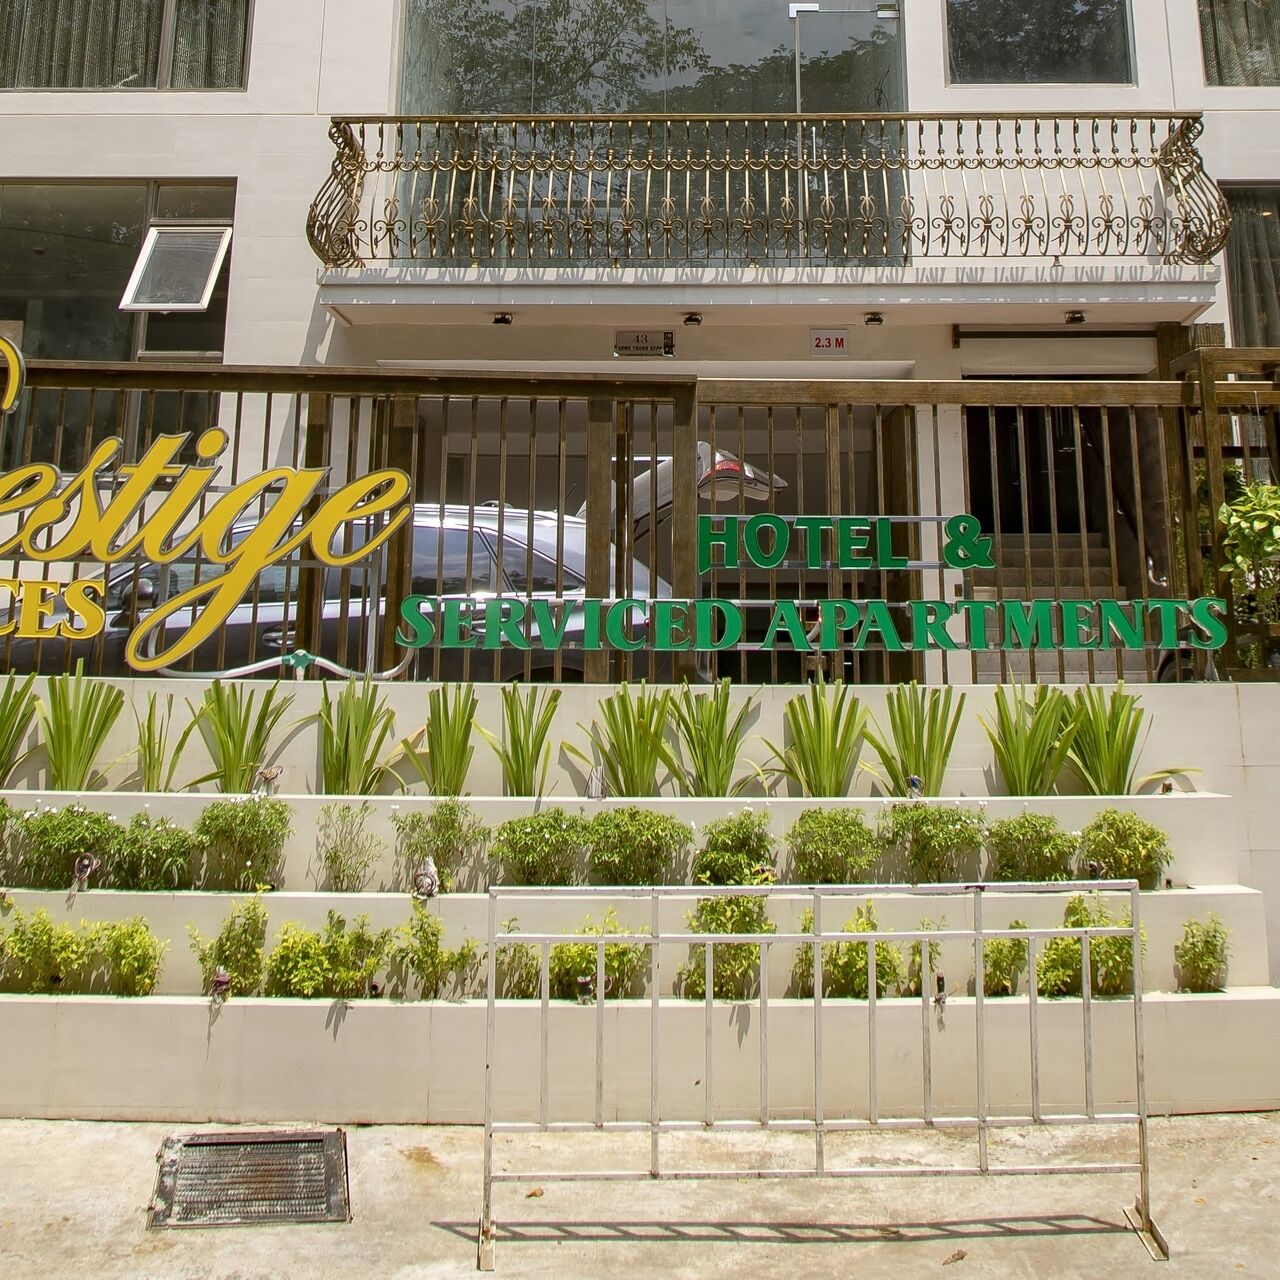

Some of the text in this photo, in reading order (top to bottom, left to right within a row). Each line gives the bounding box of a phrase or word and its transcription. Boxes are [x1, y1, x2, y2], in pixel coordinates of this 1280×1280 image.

[632, 333, 649, 344] 43
[815, 337, 844, 348] 2.3 M
[698, 514, 996, 575] HOTEL &
[395, 596, 1228, 652] SERVICED APARTMENTS
